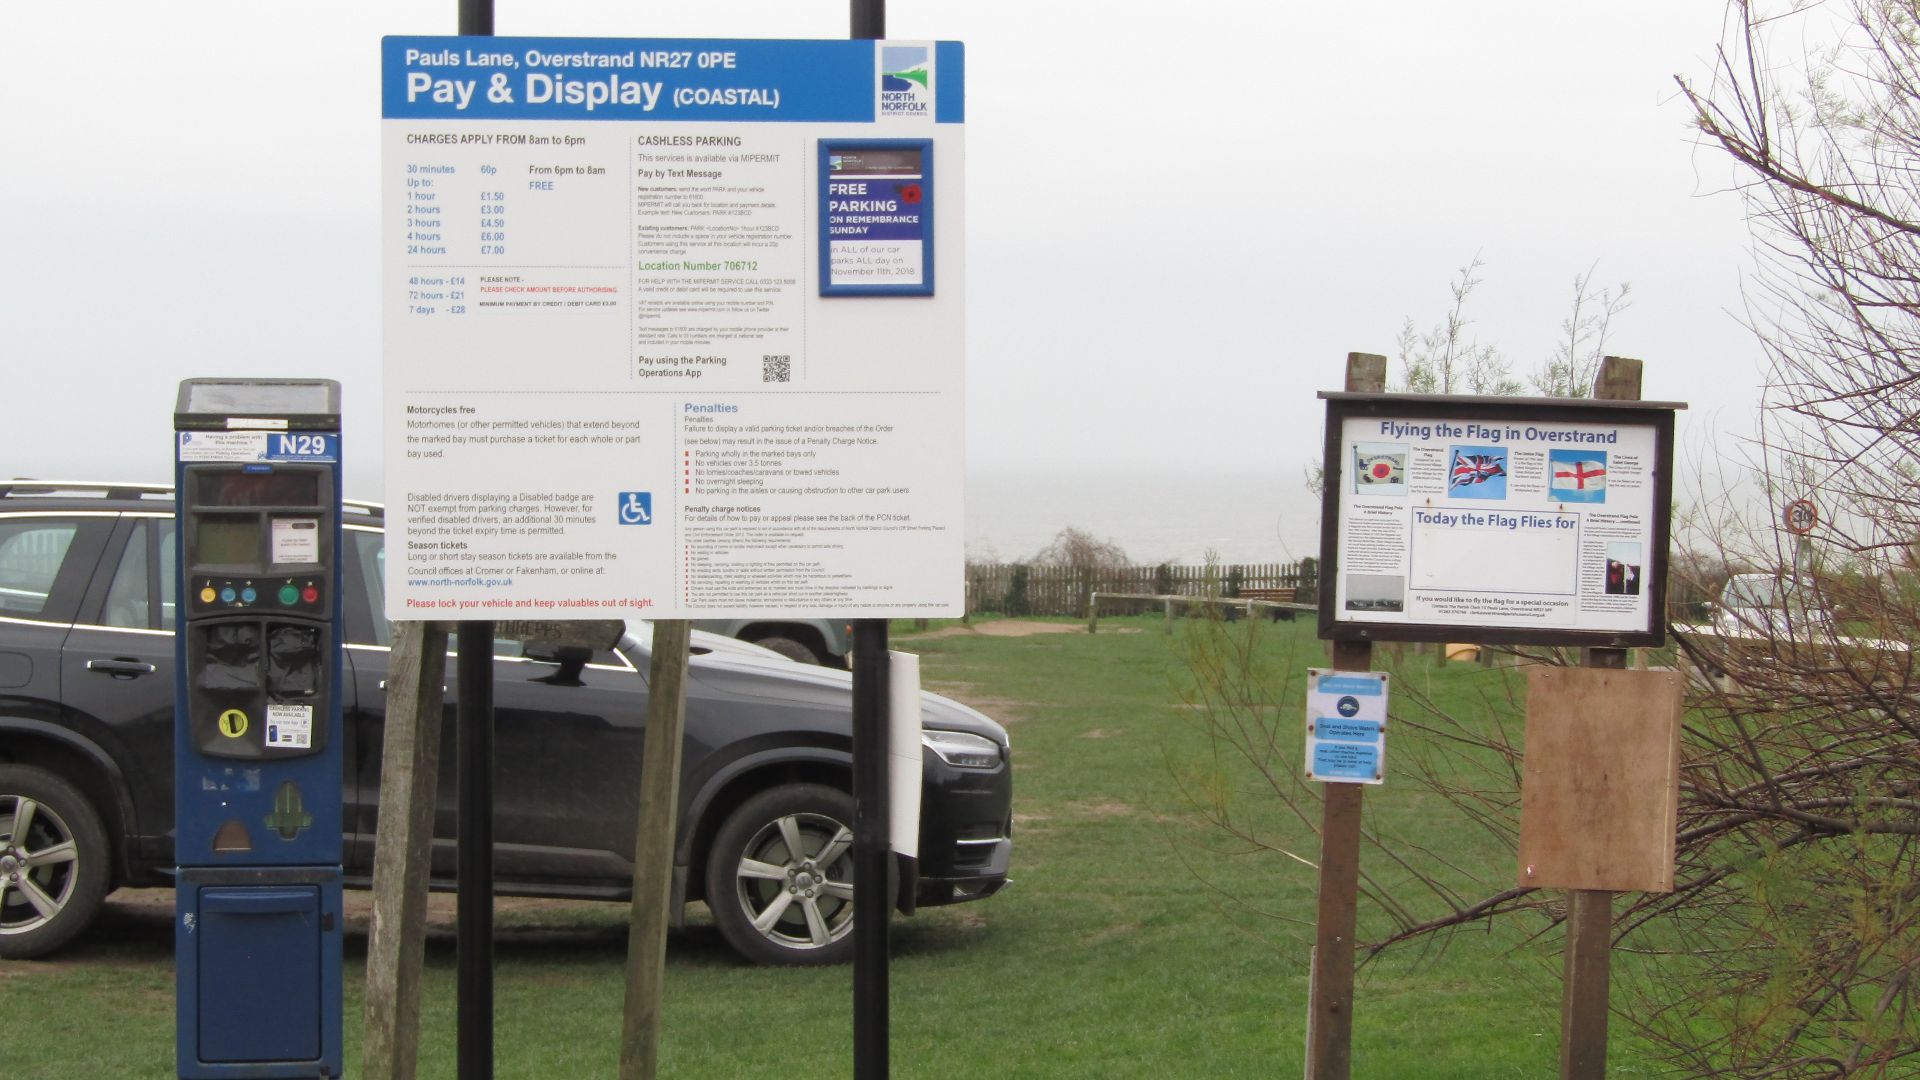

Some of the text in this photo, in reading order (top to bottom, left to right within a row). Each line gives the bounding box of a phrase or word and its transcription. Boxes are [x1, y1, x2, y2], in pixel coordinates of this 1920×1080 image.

[406, 49, 736, 69] Pauls Lane, Overstrand NR27 0PE
[408, 72, 663, 111] Pay & Display
[674, 88, 780, 108] (COASTAL)
[882, 93, 914, 101] NORTH
[882, 102, 927, 111] NORFOLK
[407, 134, 585, 147] CHARGES APPLY FROM 8am to 6pm
[638, 136, 741, 146] CASHLESS PARKING
[638, 154, 653, 162] This
[695, 154, 726, 162] available
[728, 154, 738, 162] via
[741, 154, 780, 162] MIPERMIT
[408, 164, 455, 174] 30 minutes
[481, 165, 496, 176] 60p
[530, 165, 605, 176] From 6pm to 8am
[638, 169, 722, 179] Pay by Text Message
[408, 178, 420, 188] Up
[530, 181, 553, 190] FREE
[830, 184, 867, 194] FREE
[408, 192, 435, 200] 1 hour
[481, 192, 504, 200] £1.50
[408, 205, 440, 214] 2 hours
[481, 205, 504, 214] £3.00
[830, 200, 896, 212] PARKING
[408, 218, 440, 227] 3 hours
[481, 219, 504, 228] £4.50
[830, 226, 868, 234] SUNDAY
[408, 232, 440, 240] 4 hours
[481, 232, 504, 241] £6.00
[408, 245, 446, 254] 24 hours
[481, 246, 504, 254] £7.00
[639, 261, 757, 270] Location Number 706712
[875, 257, 890, 265] day
[409, 277, 418, 285] 48
[421, 277, 443, 285] hours
[450, 277, 464, 285] £14
[409, 291, 418, 299] 72
[420, 292, 444, 300] hours
[450, 291, 464, 300] £21
[416, 306, 435, 315] days
[451, 306, 465, 314] £28
[639, 356, 726, 366] Pay using the Parking
[639, 368, 701, 378] Operations App
[407, 406, 475, 416] Motorcycles free
[685, 403, 738, 413] Penalties
[1380, 421, 1617, 444] Flying the Flag in Overstrand
[280, 434, 325, 454] N29
[685, 506, 709, 515] Penalty
[712, 506, 734, 515] charge
[1416, 512, 1576, 530] Today the Flag Flies for
[408, 541, 468, 549] Season tickets
[408, 578, 512, 588] www.north-norfolk.gov.uk
[407, 598, 653, 610] Please lock your vehicle and keep valuables out of sight.
